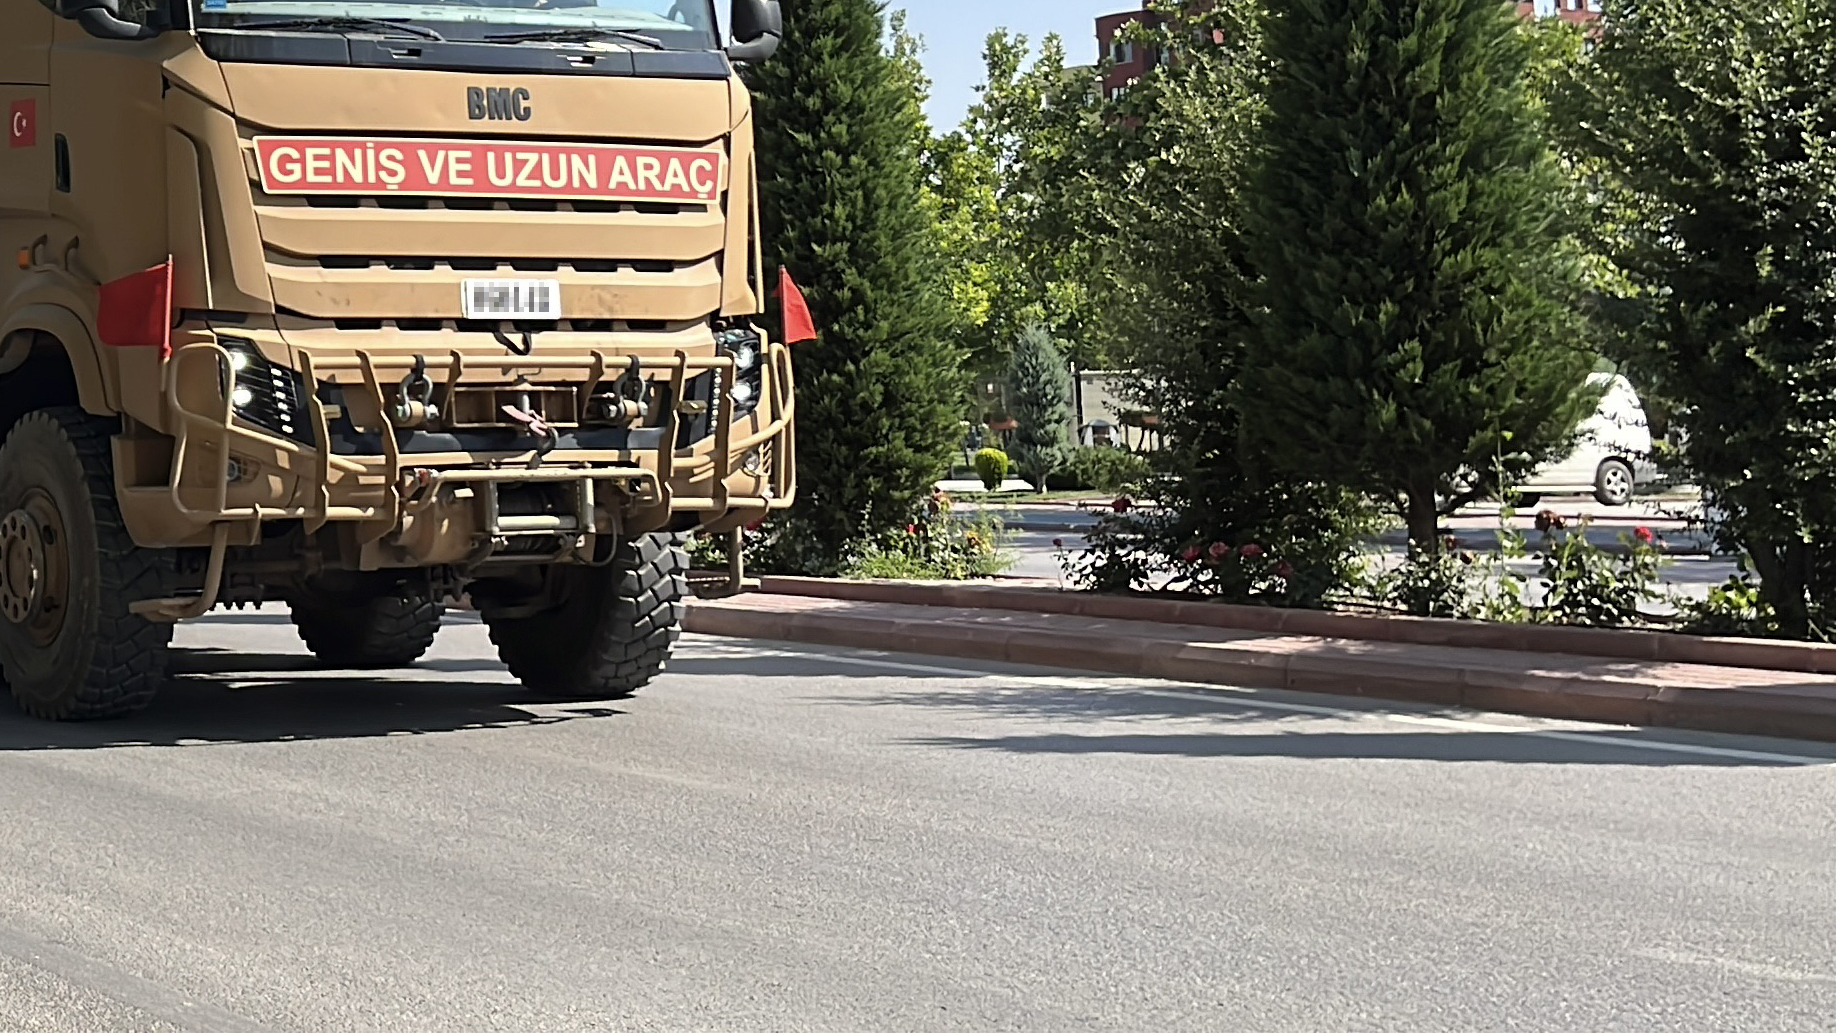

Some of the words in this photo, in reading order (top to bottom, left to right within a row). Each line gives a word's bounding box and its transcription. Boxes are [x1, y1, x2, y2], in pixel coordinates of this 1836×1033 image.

[466, 86, 532, 121] BMC
[269, 142, 406, 190] GENİŞ
[417, 149, 474, 185] VE
[486, 151, 598, 189] UZUN
[608, 155, 714, 199] ARAÇ
